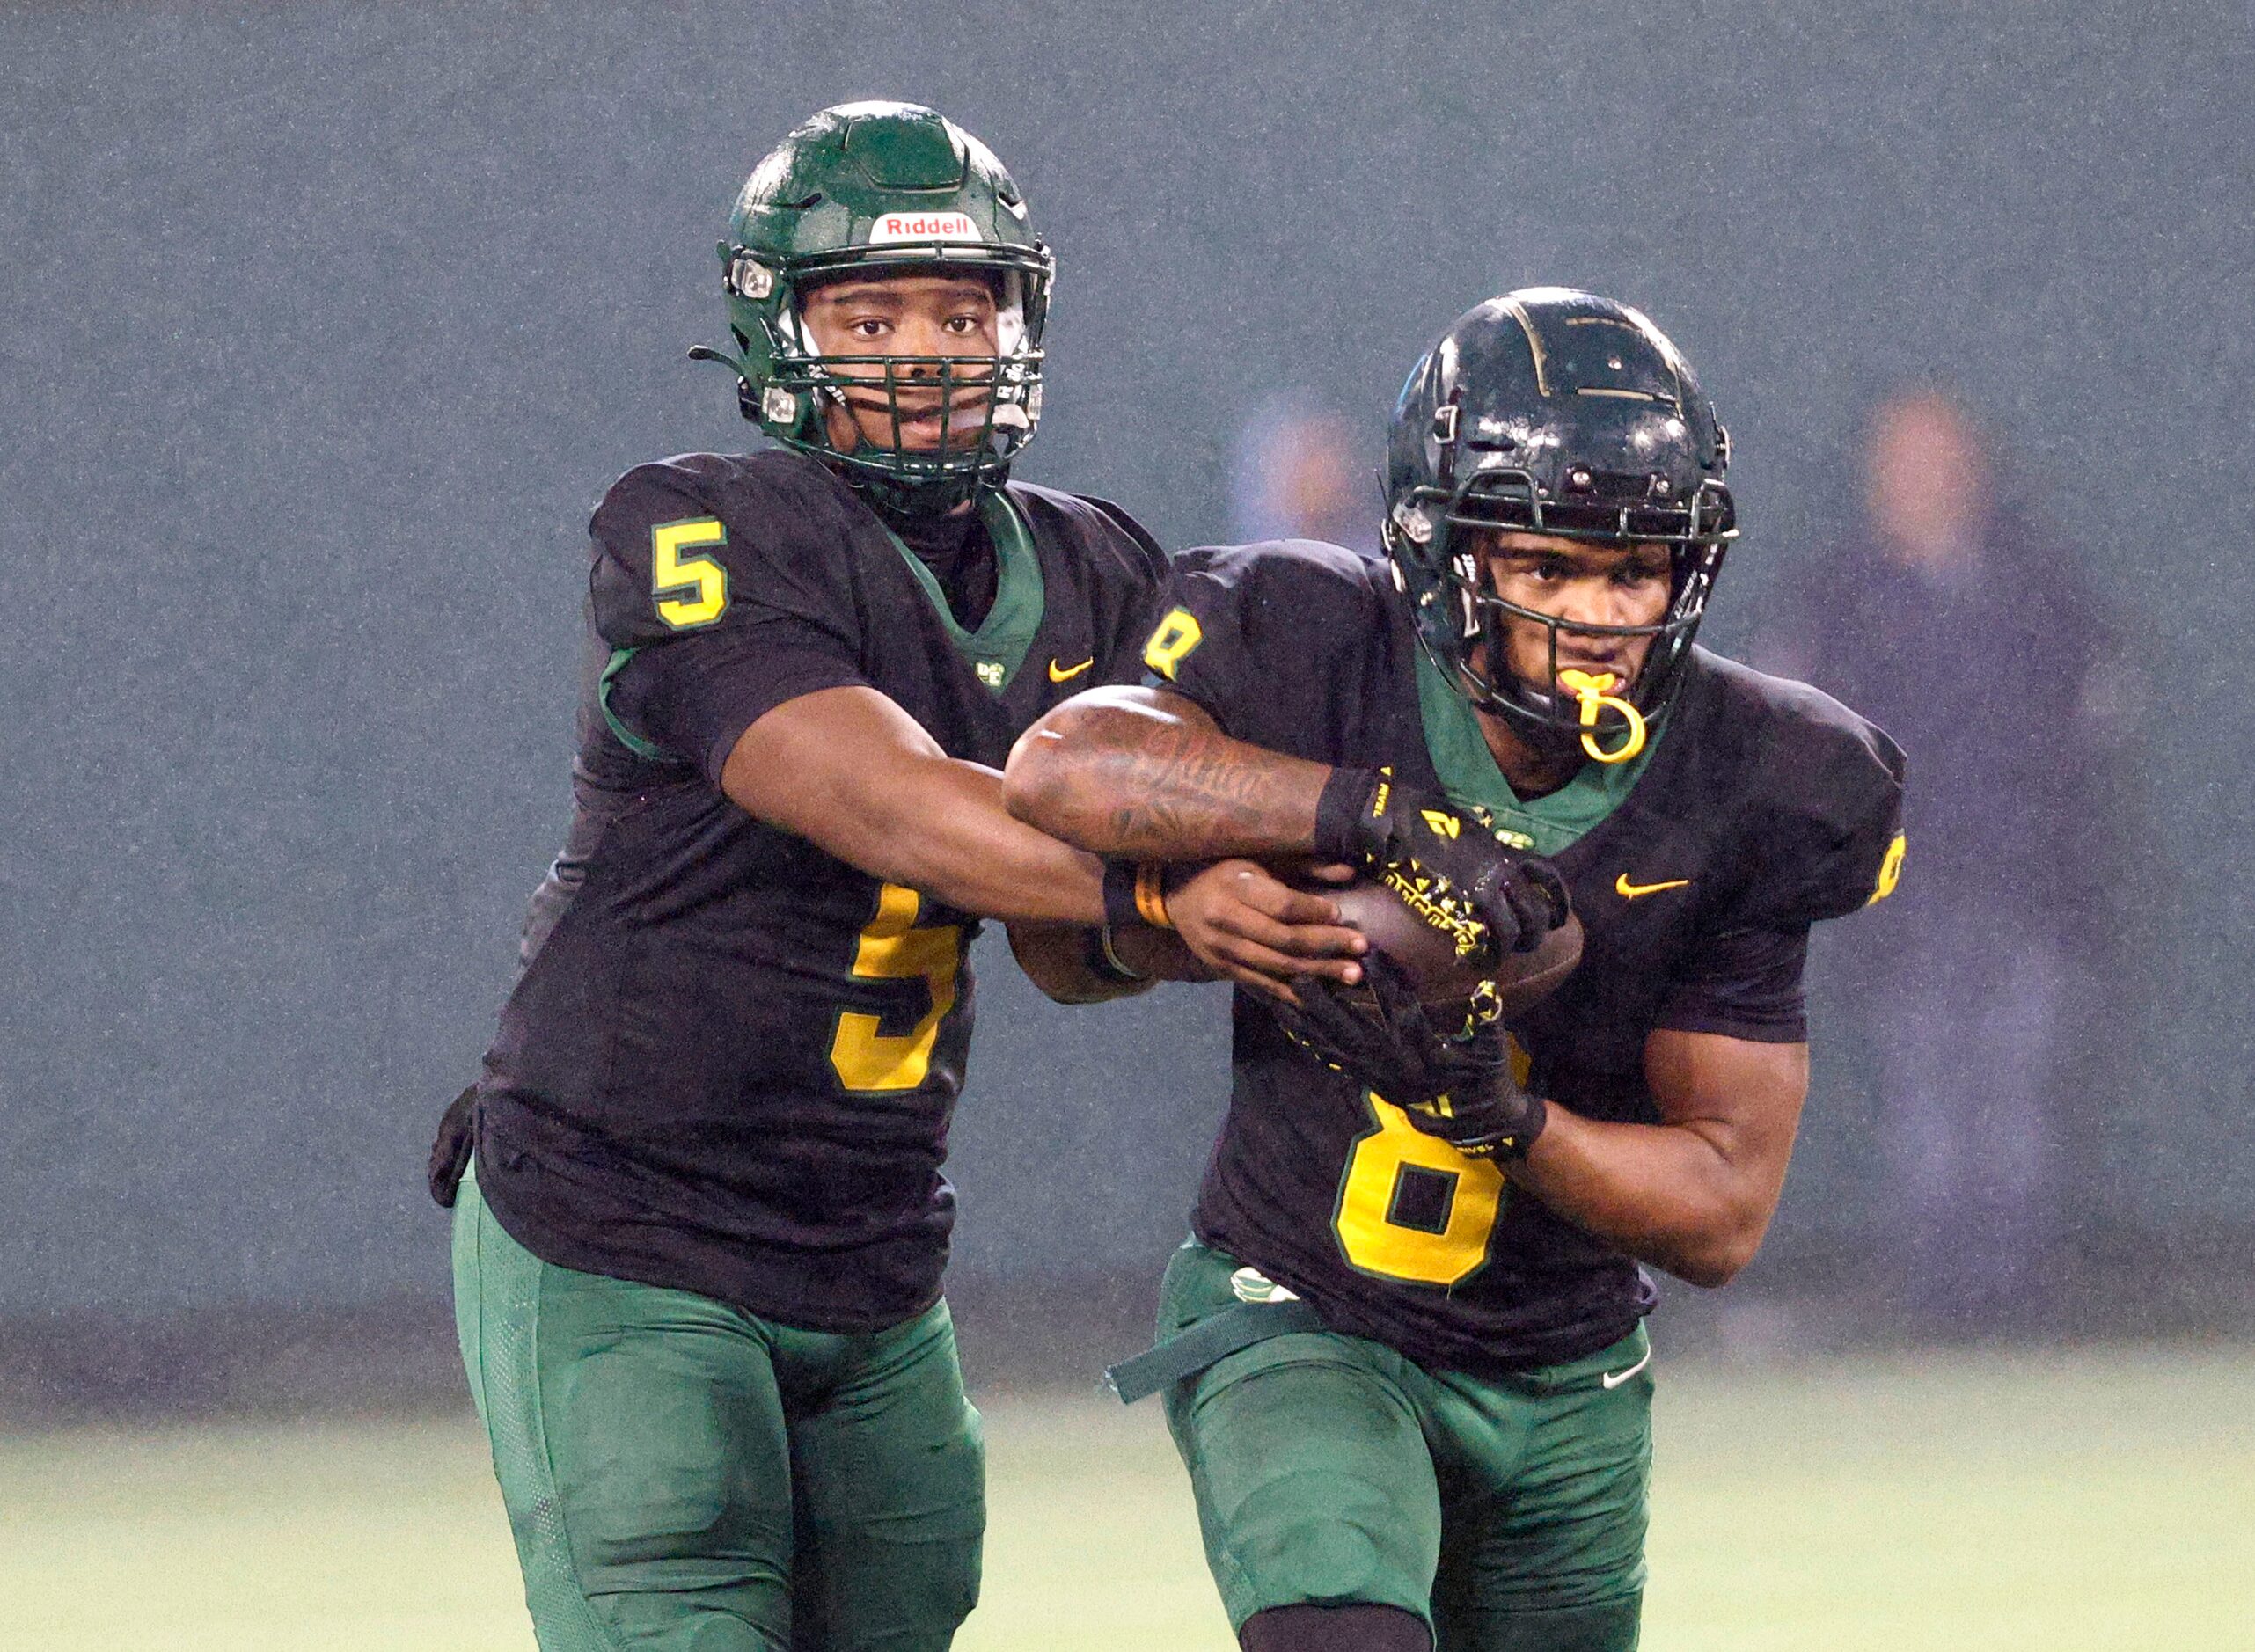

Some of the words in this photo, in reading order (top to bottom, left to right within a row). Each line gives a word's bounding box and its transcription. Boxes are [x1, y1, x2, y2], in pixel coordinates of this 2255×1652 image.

[886, 217, 969, 235] Riddell
[652, 517, 729, 630] 5
[827, 882, 961, 1093] 5
